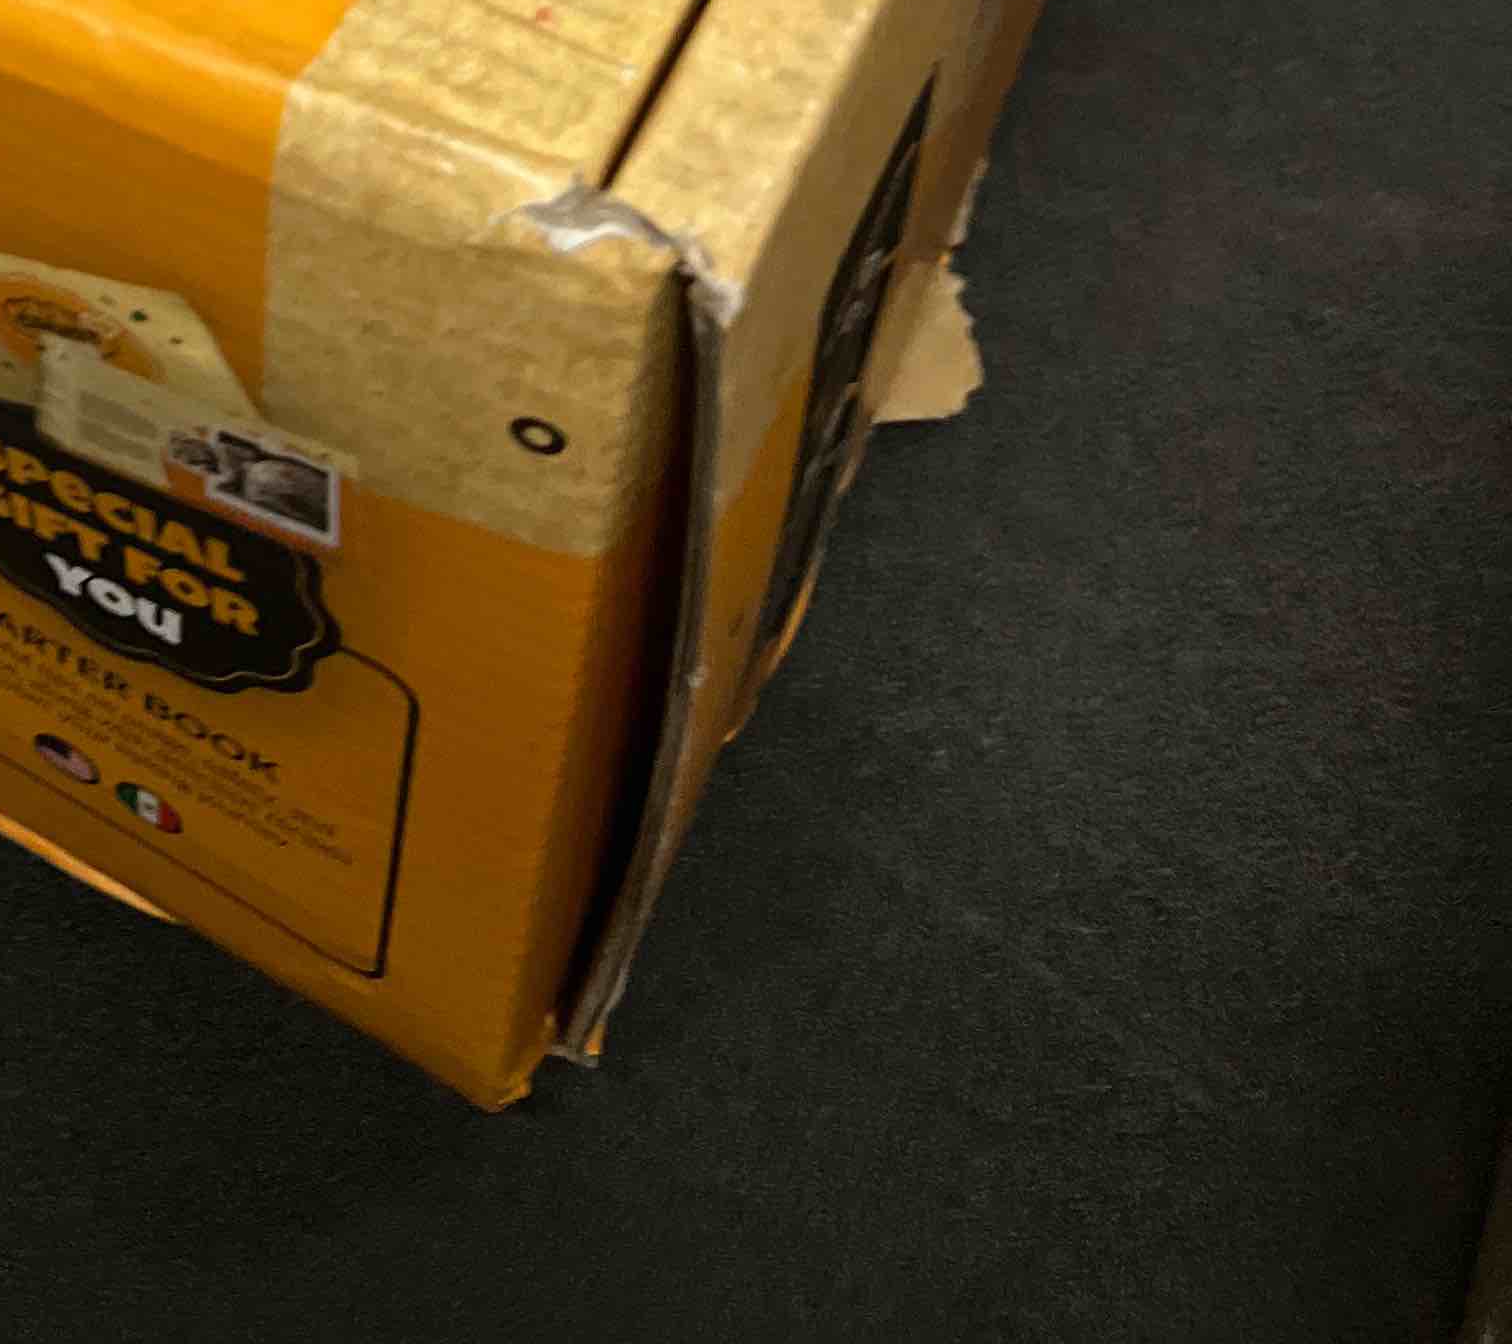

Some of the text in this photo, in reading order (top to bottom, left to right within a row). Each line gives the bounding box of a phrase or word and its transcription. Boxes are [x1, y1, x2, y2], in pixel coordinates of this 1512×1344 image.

[44, 551, 184, 647] YOU
[123, 546, 261, 637] FOR
[143, 691, 282, 773] BOOK
